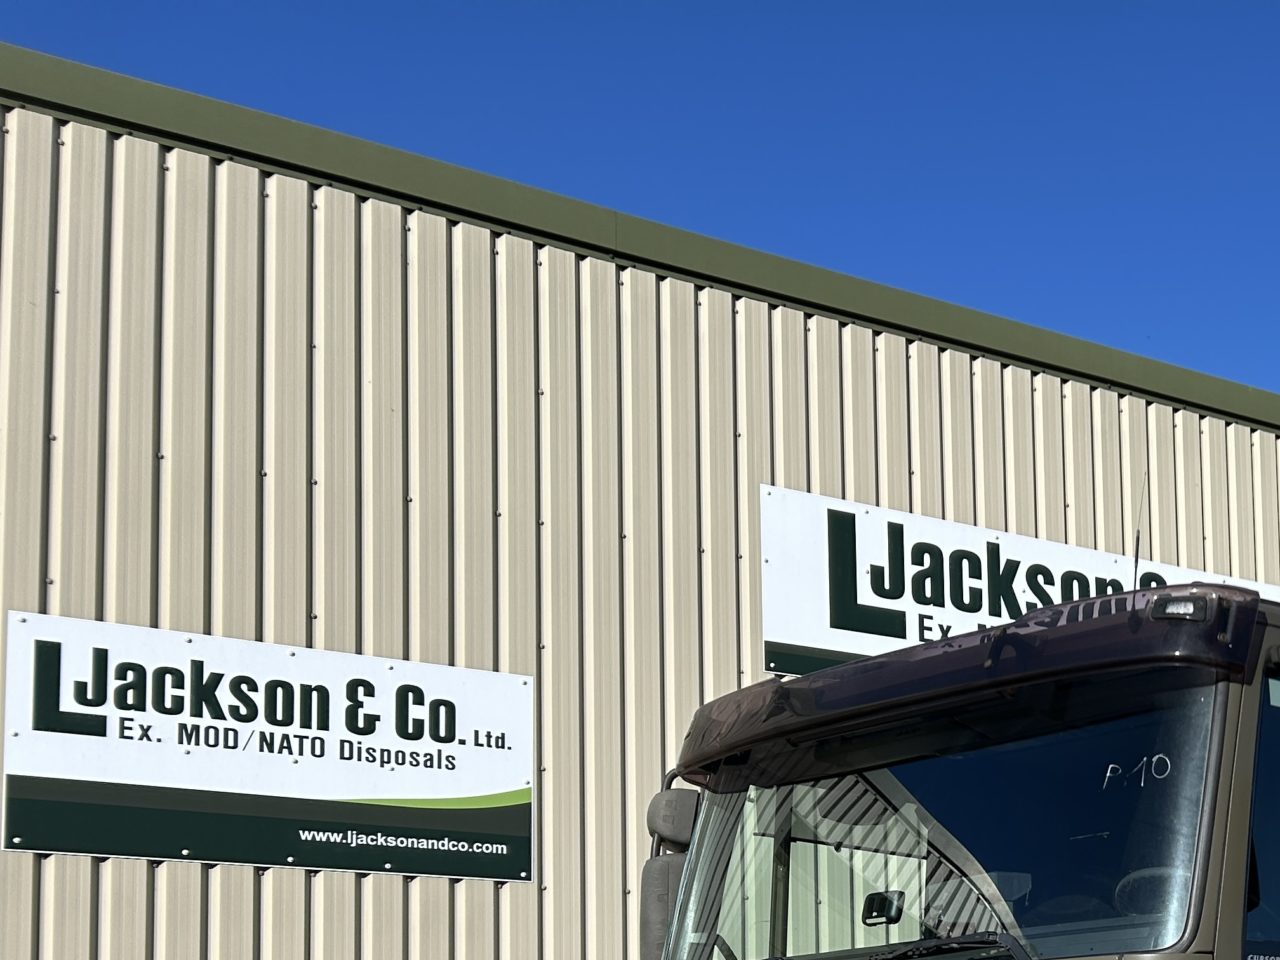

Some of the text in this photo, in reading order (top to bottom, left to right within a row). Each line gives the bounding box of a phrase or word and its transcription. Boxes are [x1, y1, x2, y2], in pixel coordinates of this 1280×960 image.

[345, 678, 381, 736] &
[395, 684, 467, 745] Co.
[474, 728, 512, 751] Ltd.
[119, 717, 457, 772] Ex. MOD/NATO Disposals
[299, 827, 507, 856] www.ljacksonandco.com
